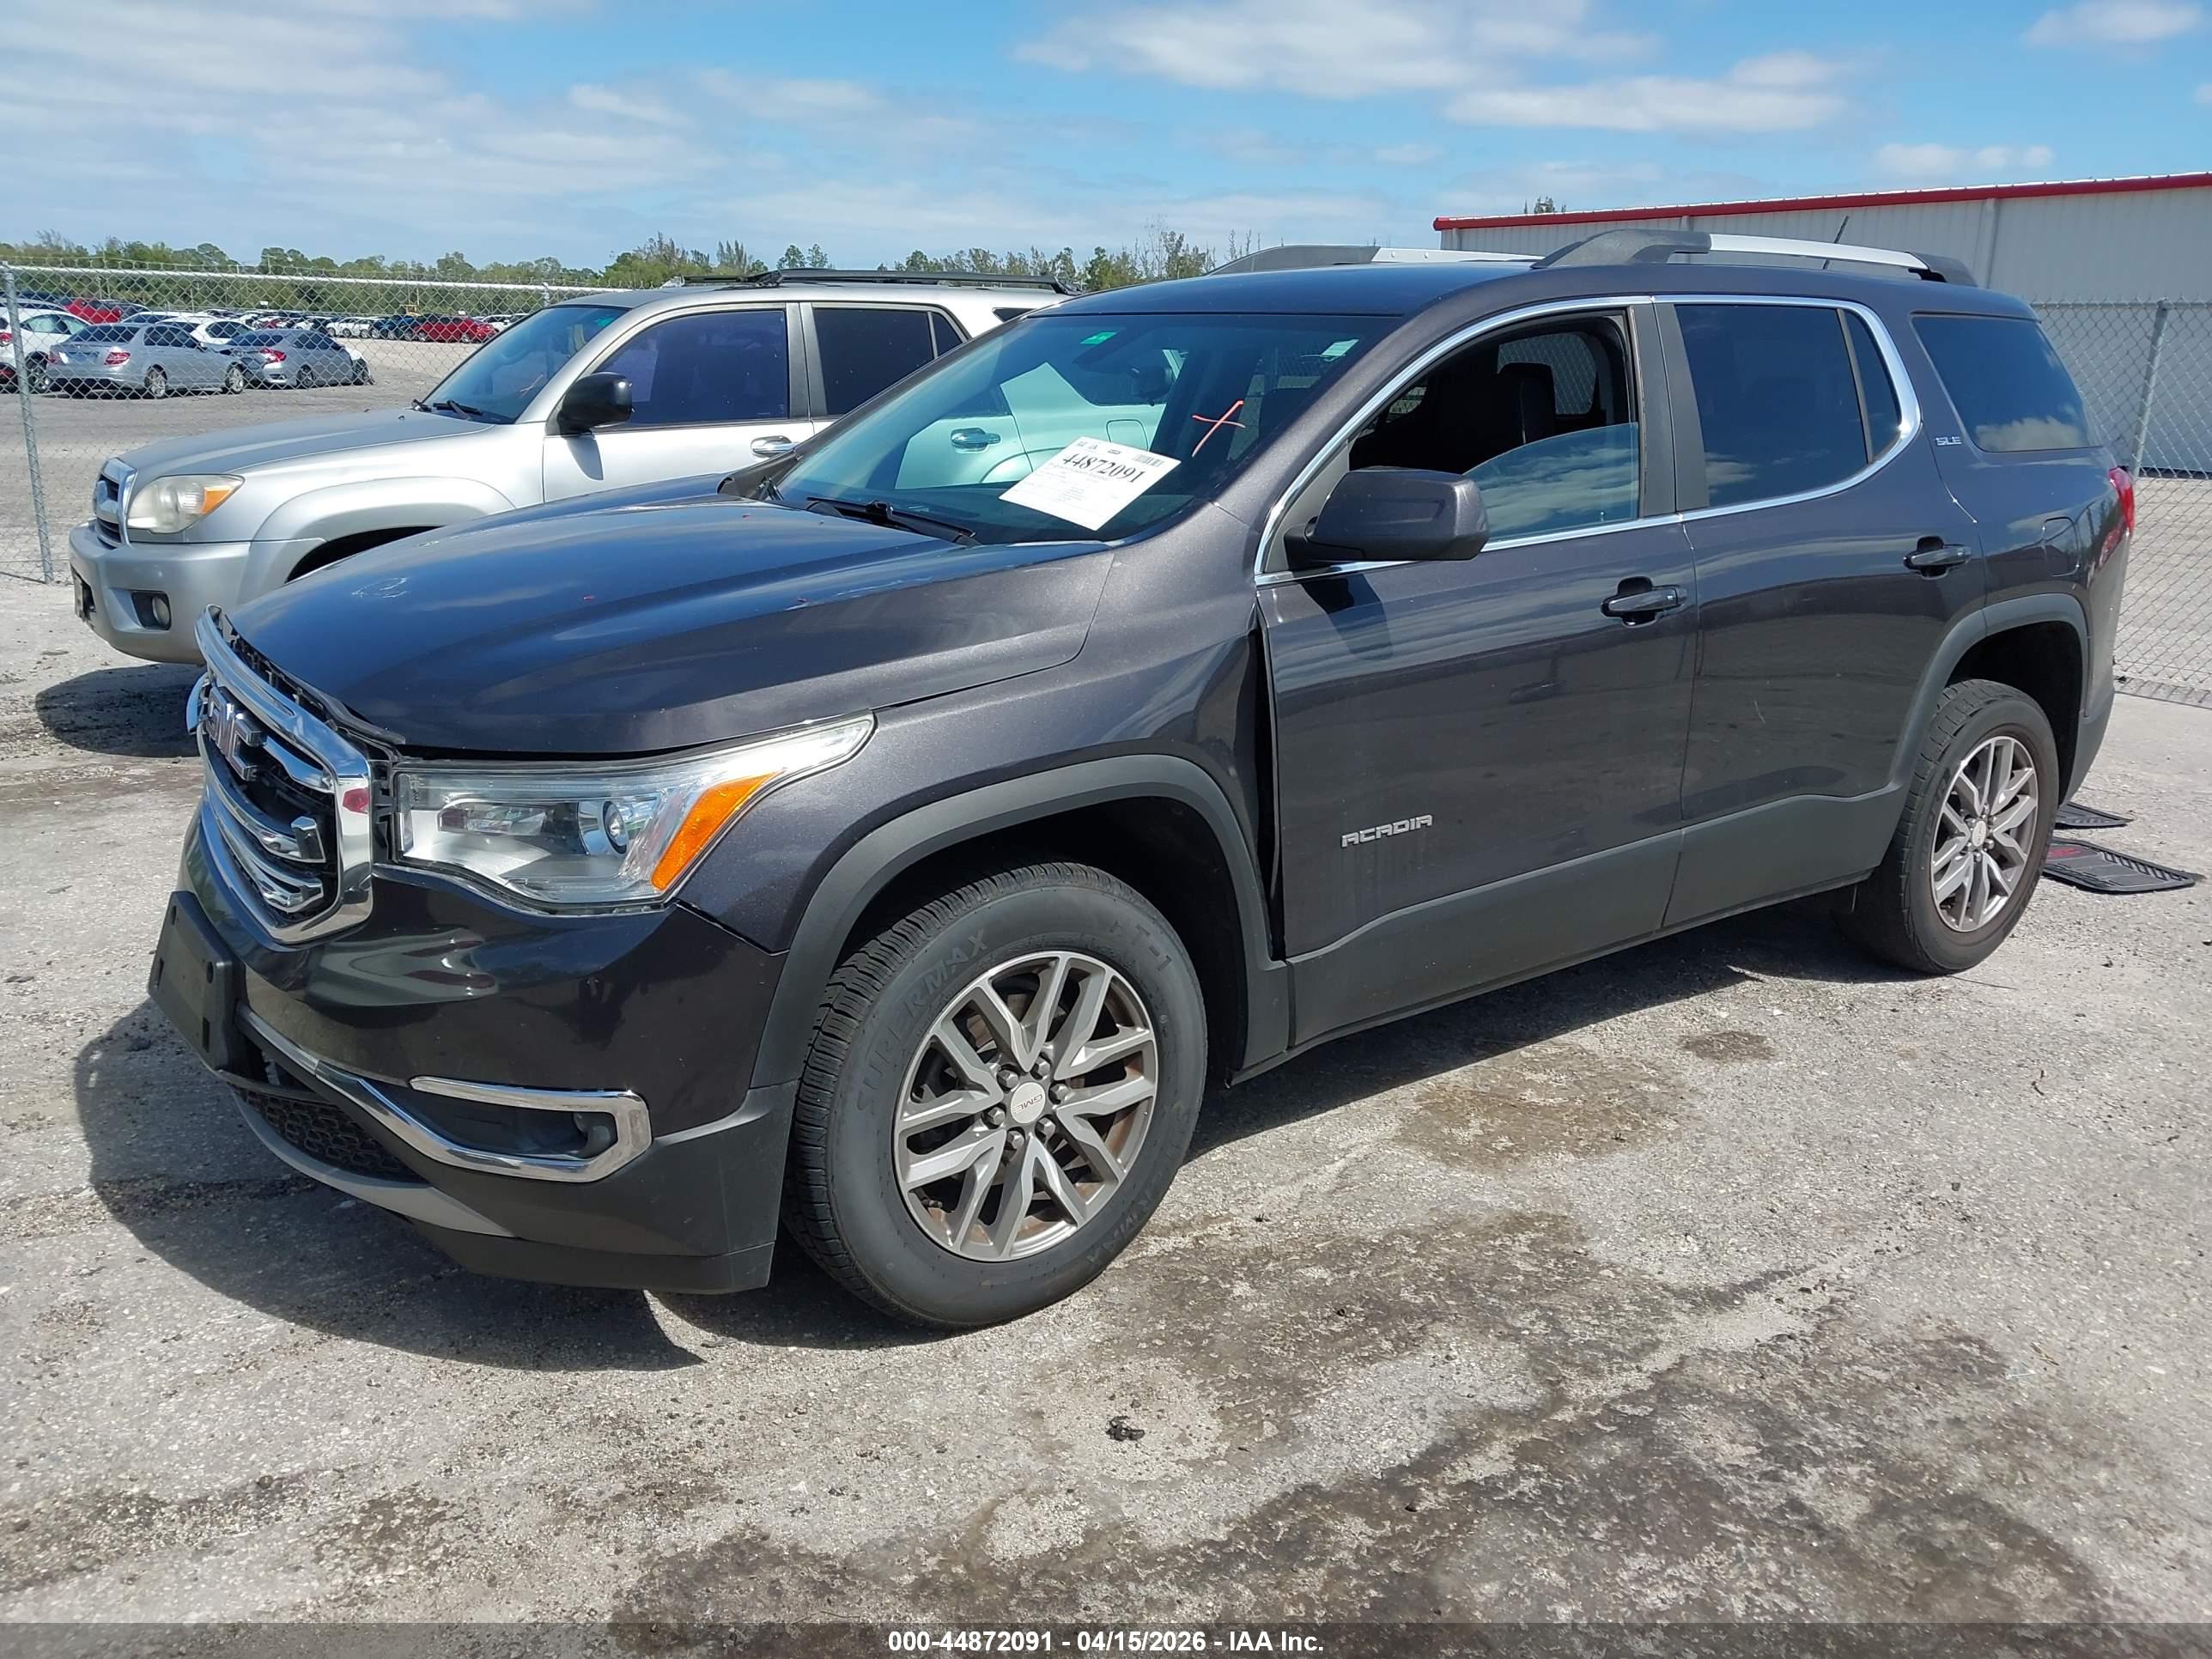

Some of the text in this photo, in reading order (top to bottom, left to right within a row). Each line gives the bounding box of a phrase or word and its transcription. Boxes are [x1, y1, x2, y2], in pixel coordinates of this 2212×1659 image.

[1063, 453, 1146, 483] 44872091
[206, 686, 261, 782] GMC
[1340, 814, 1433, 848] ACADIA
[1012, 1093, 1043, 1114] GMC
